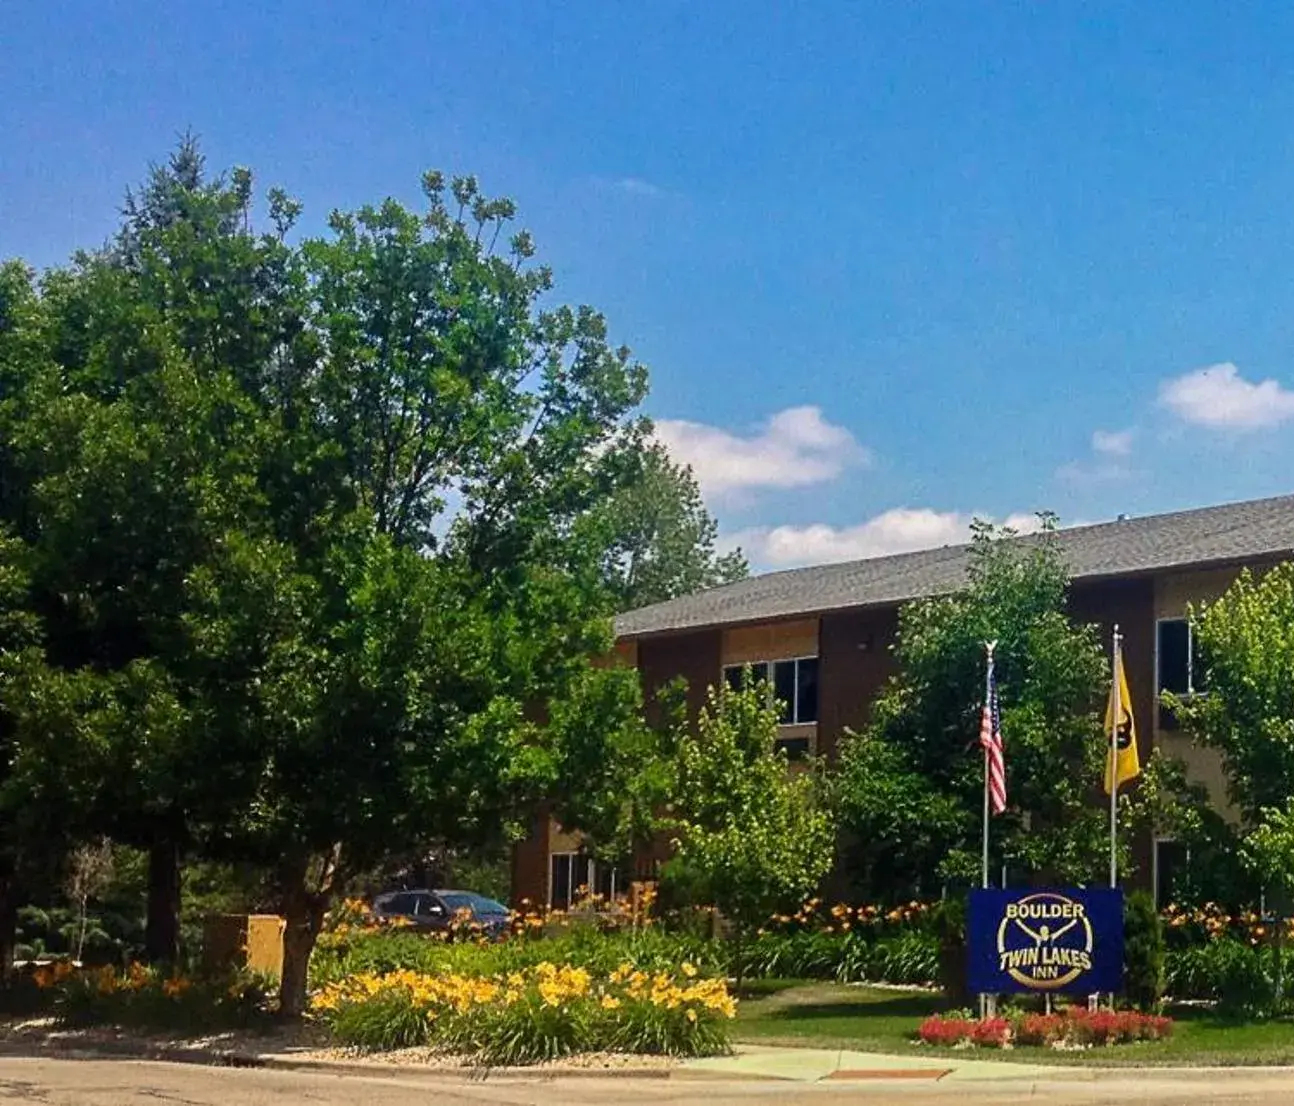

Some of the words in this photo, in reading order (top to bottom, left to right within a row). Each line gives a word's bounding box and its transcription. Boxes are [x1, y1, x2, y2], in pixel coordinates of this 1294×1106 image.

[1006, 903, 1085, 918] BOULDER
[1000, 948, 1038, 971] TWIN
[1042, 948, 1092, 970] LAKES
[1032, 966, 1059, 978] INN
